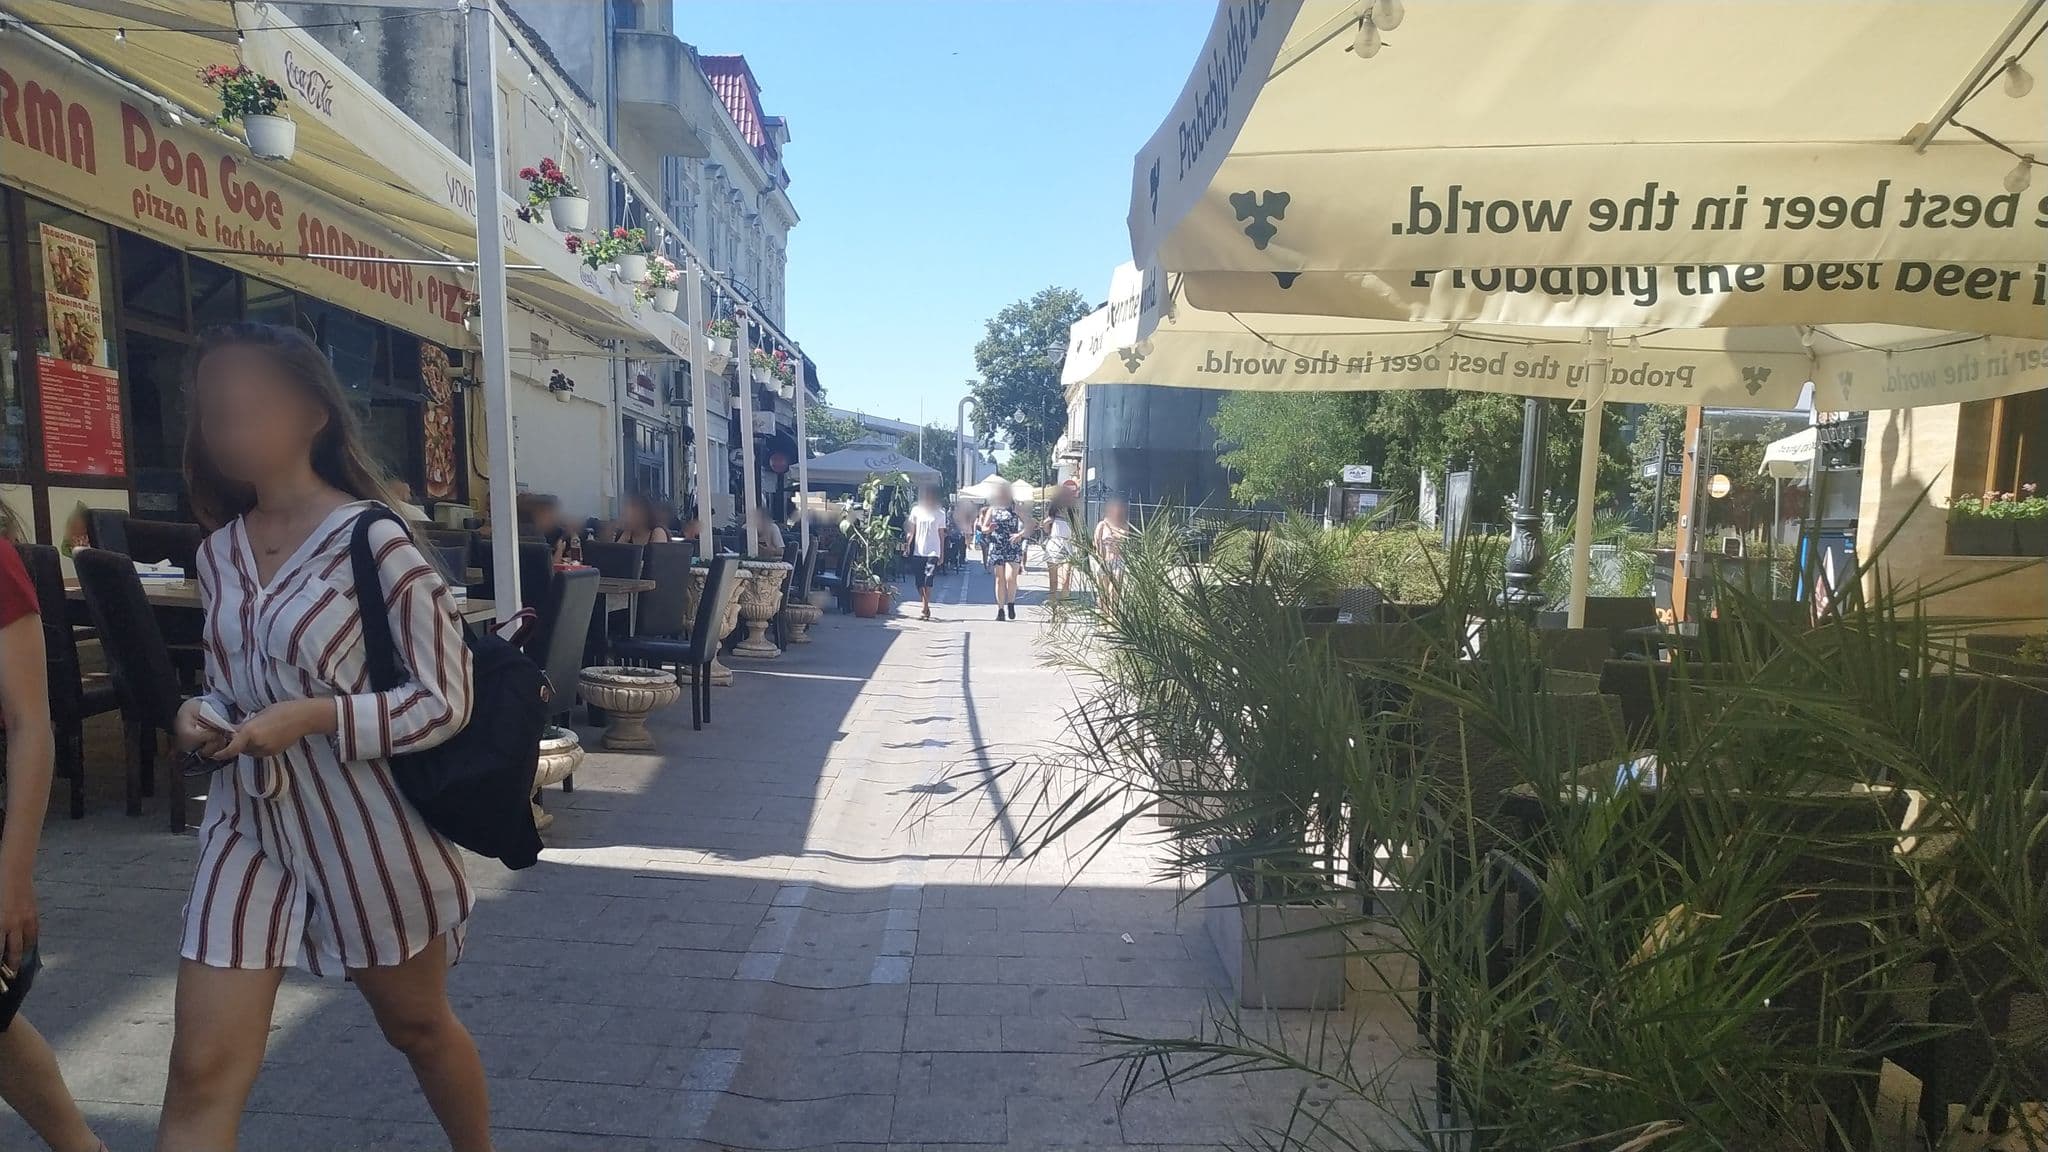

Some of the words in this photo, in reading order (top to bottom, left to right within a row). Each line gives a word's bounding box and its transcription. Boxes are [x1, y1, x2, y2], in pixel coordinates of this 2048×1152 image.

[1178, 47, 1229, 182] Probably
[1227, 5, 1248, 92] the
[120, 101, 209, 199] Don
[219, 155, 285, 231] Goe
[132, 184, 189, 231] pizza
[195, 206, 208, 238] &
[215, 214, 246, 250] fast
[250, 230, 285, 267] food
[298, 211, 415, 306] SANDWICH
